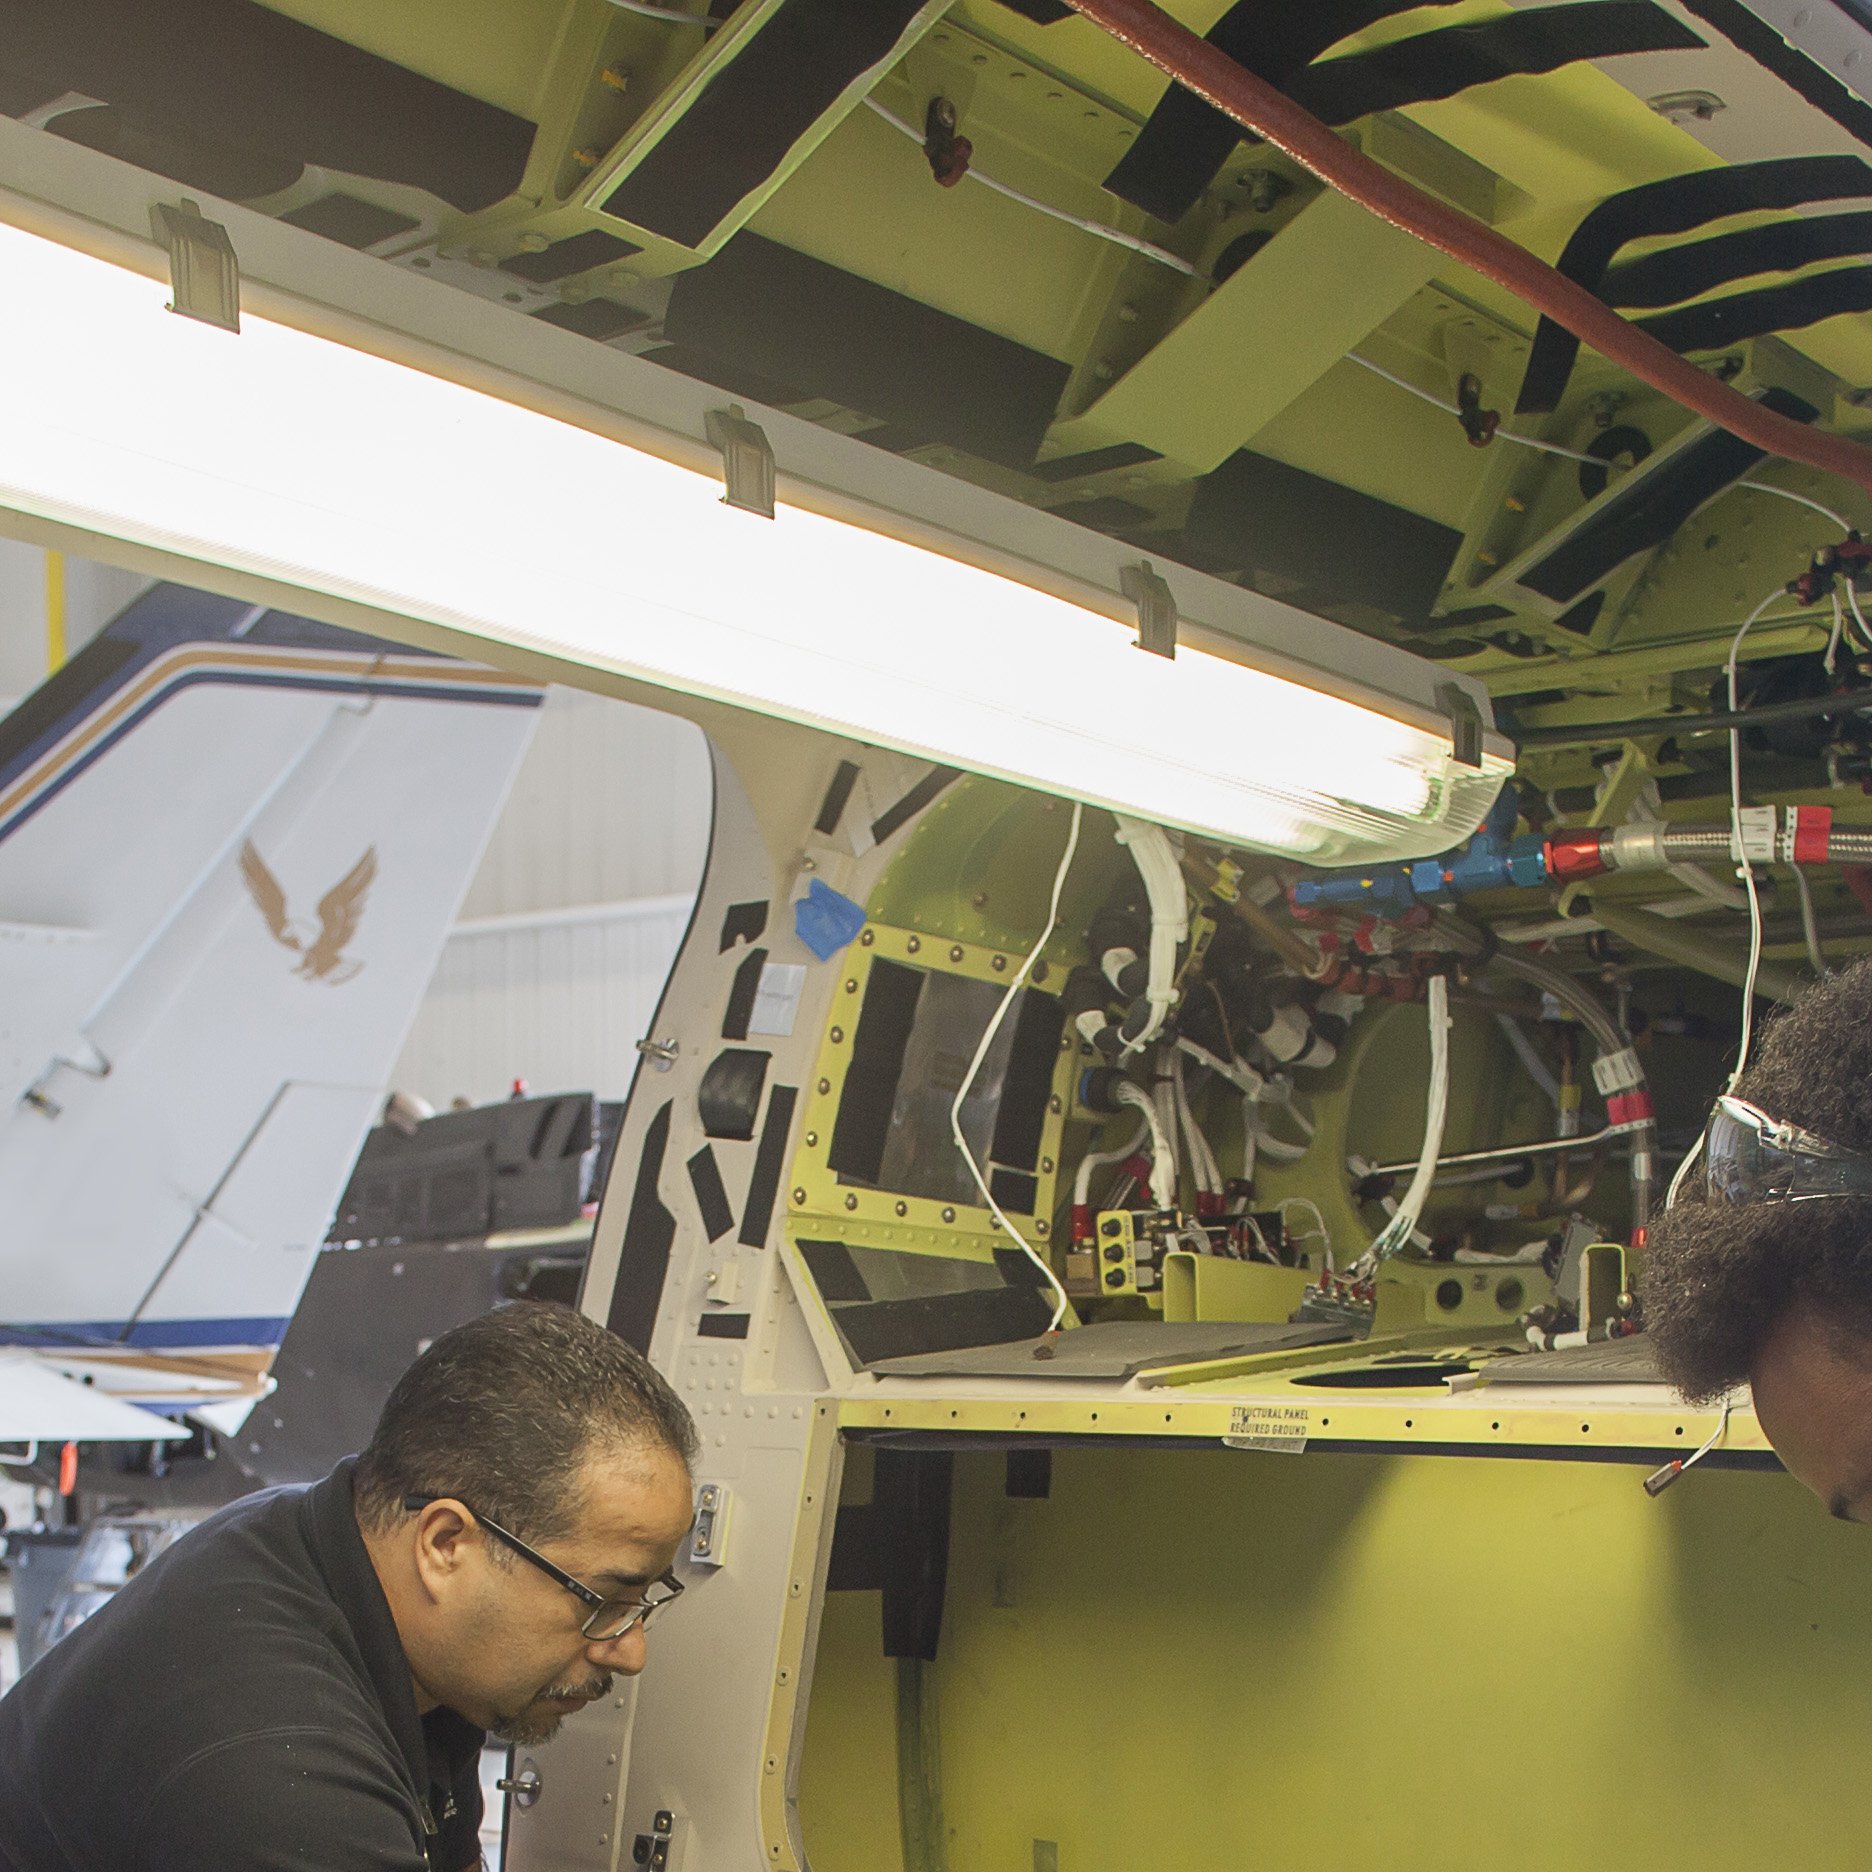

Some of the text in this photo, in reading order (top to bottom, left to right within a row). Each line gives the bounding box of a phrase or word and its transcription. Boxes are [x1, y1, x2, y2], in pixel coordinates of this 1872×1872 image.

[1231, 1406, 1309, 1420] STRUCTURAL PANEL
[1230, 1422, 1307, 1436] REQUIRED GROUND
